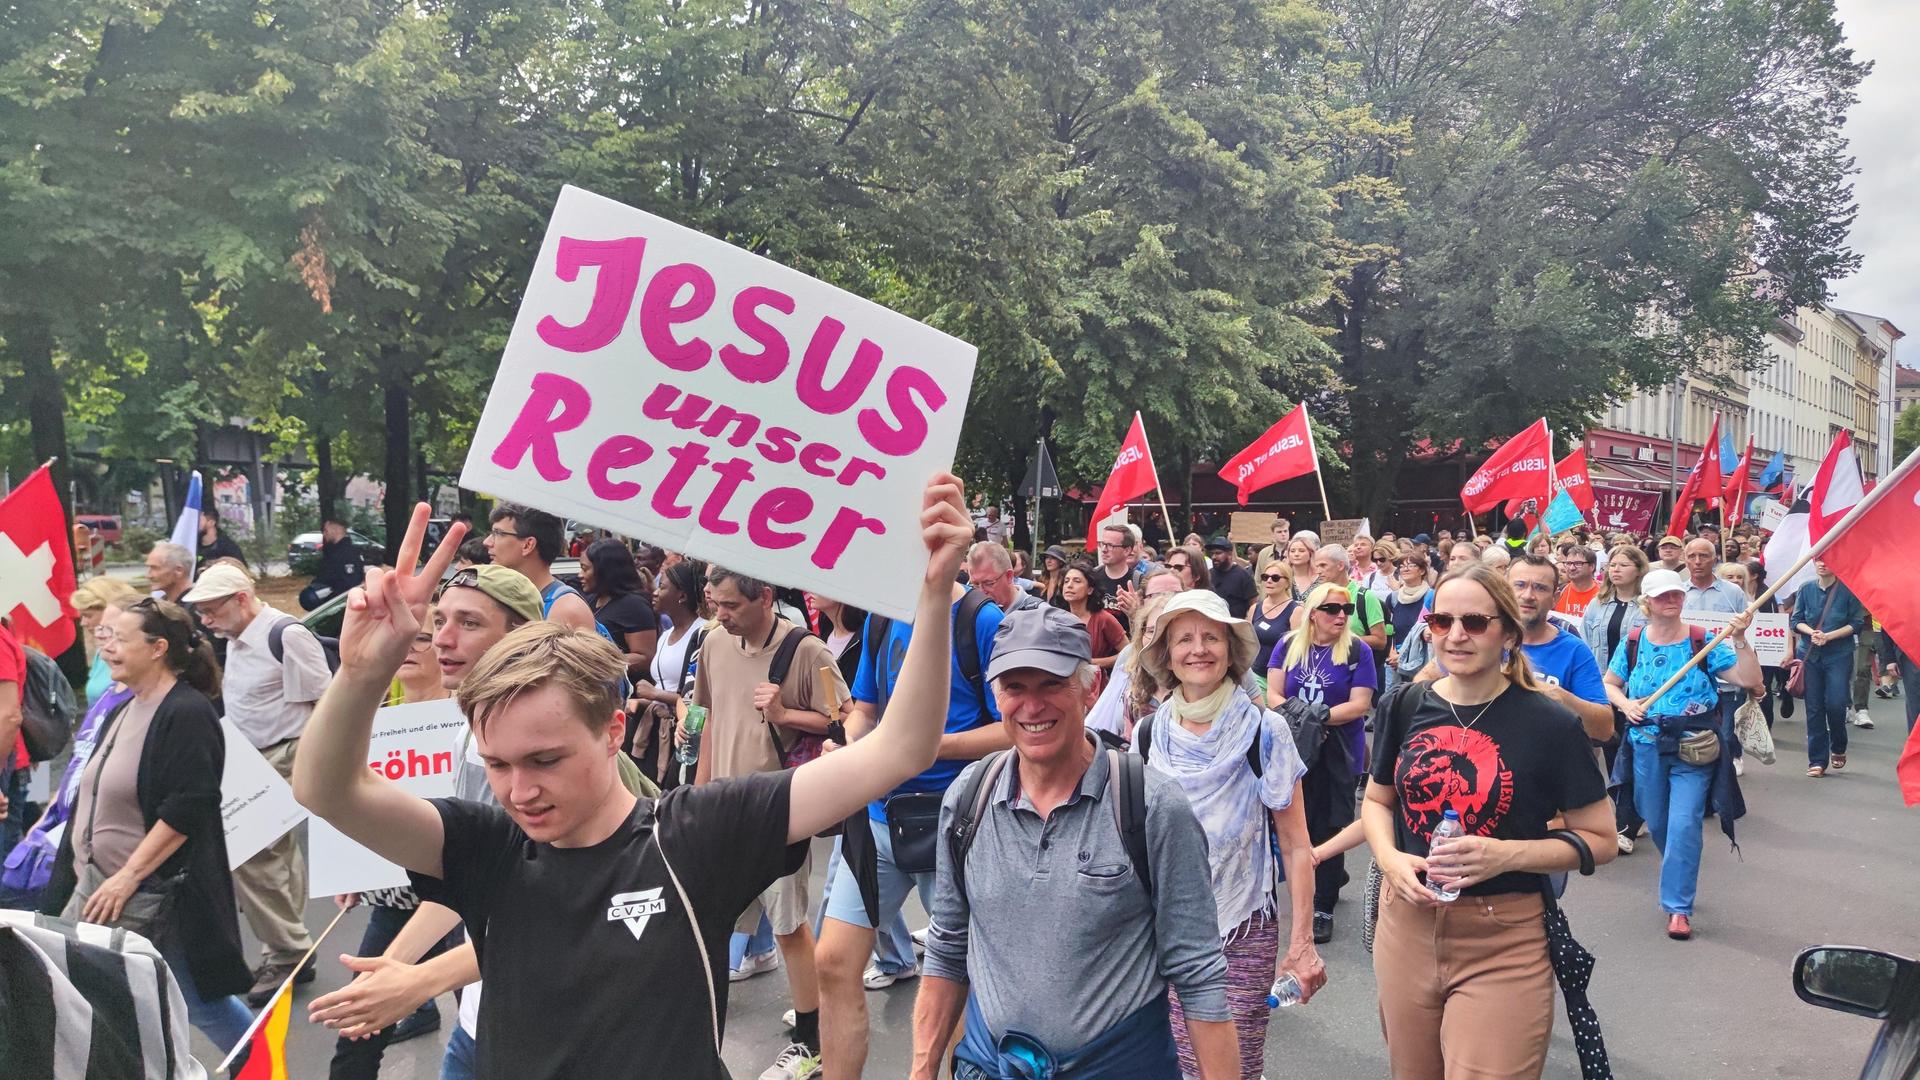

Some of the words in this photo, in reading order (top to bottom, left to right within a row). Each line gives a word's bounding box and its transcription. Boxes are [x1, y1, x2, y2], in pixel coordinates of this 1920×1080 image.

[642, 383, 886, 486] unser
[490, 372, 886, 569] Retter
[1603, 494, 1640, 511] JESUS
[379, 727, 407, 737] Freiheit
[425, 722, 438, 731] die
[440, 721, 465, 729] Werte
[1495, 770, 1514, 815] DIESEL
[611, 901, 662, 918] CVJM
